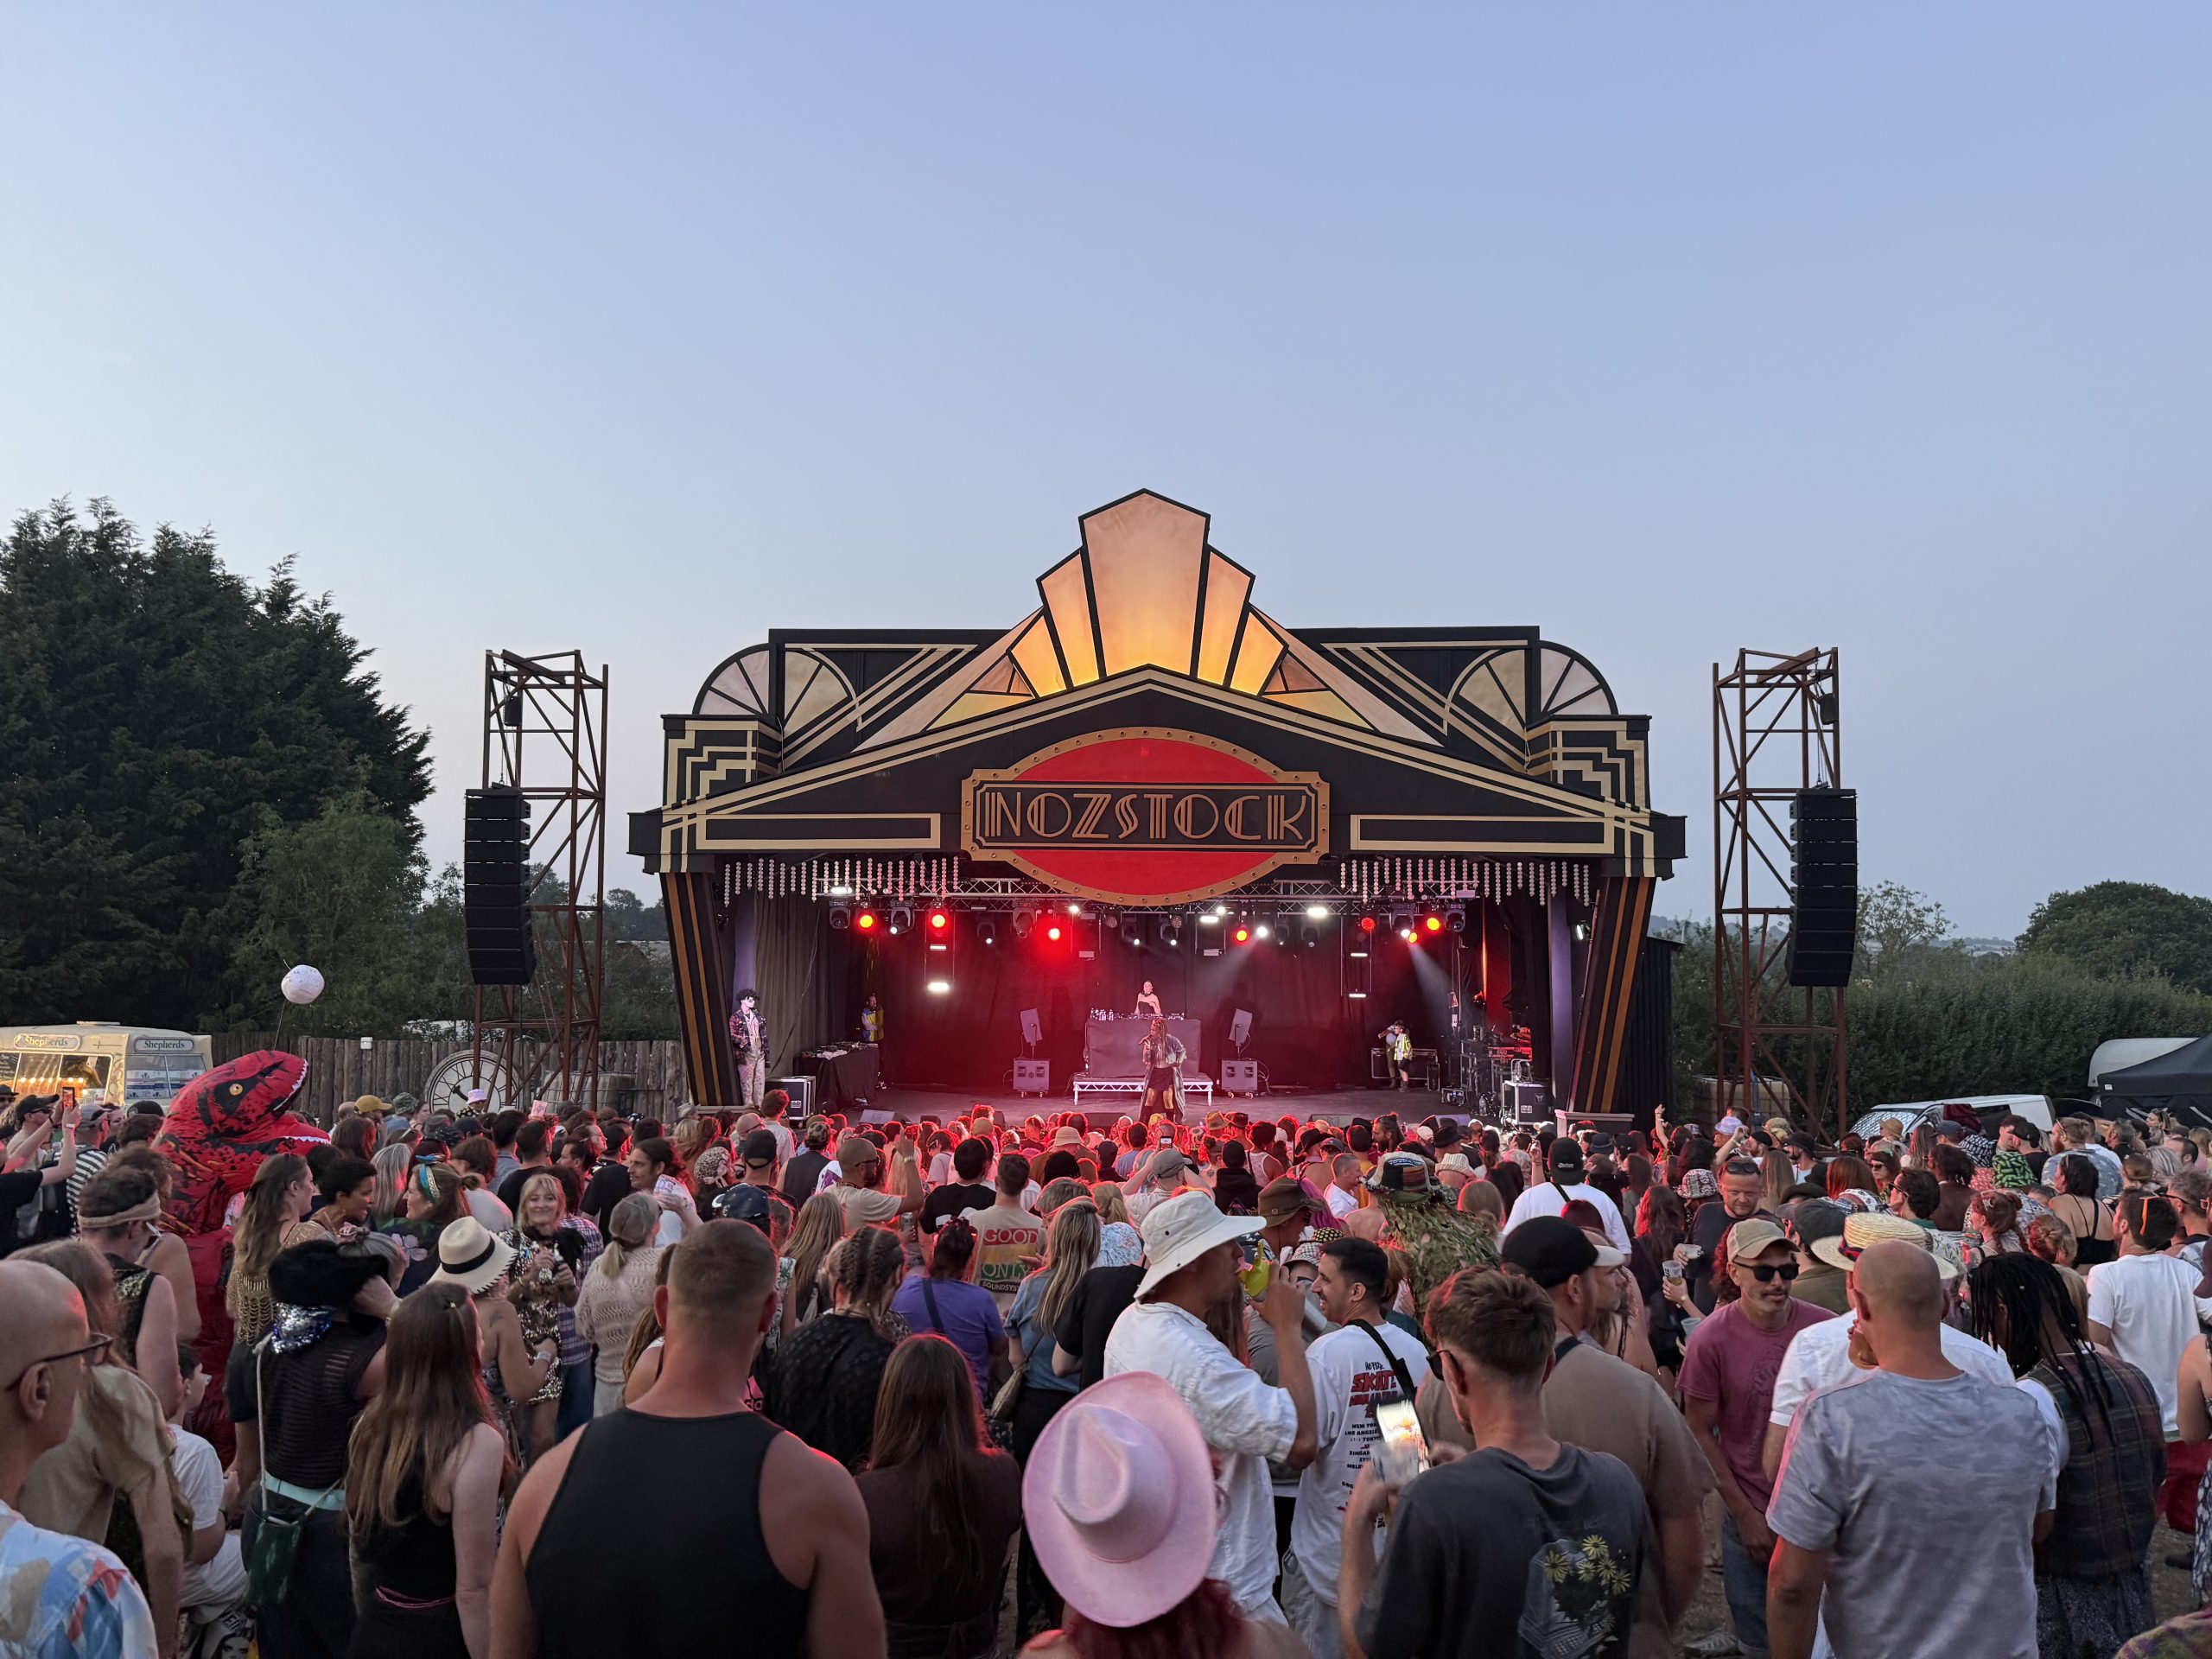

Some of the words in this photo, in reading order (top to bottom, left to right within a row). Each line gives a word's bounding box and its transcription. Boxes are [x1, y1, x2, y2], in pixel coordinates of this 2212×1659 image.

[984, 791, 1307, 841] NOZSTOCK
[144, 1040, 185, 1050] Shepherds
[984, 1229, 1039, 1245] GOOD
[982, 1263, 1031, 1279] ONLY
[982, 1282, 1020, 1292] SOUNDSYS
